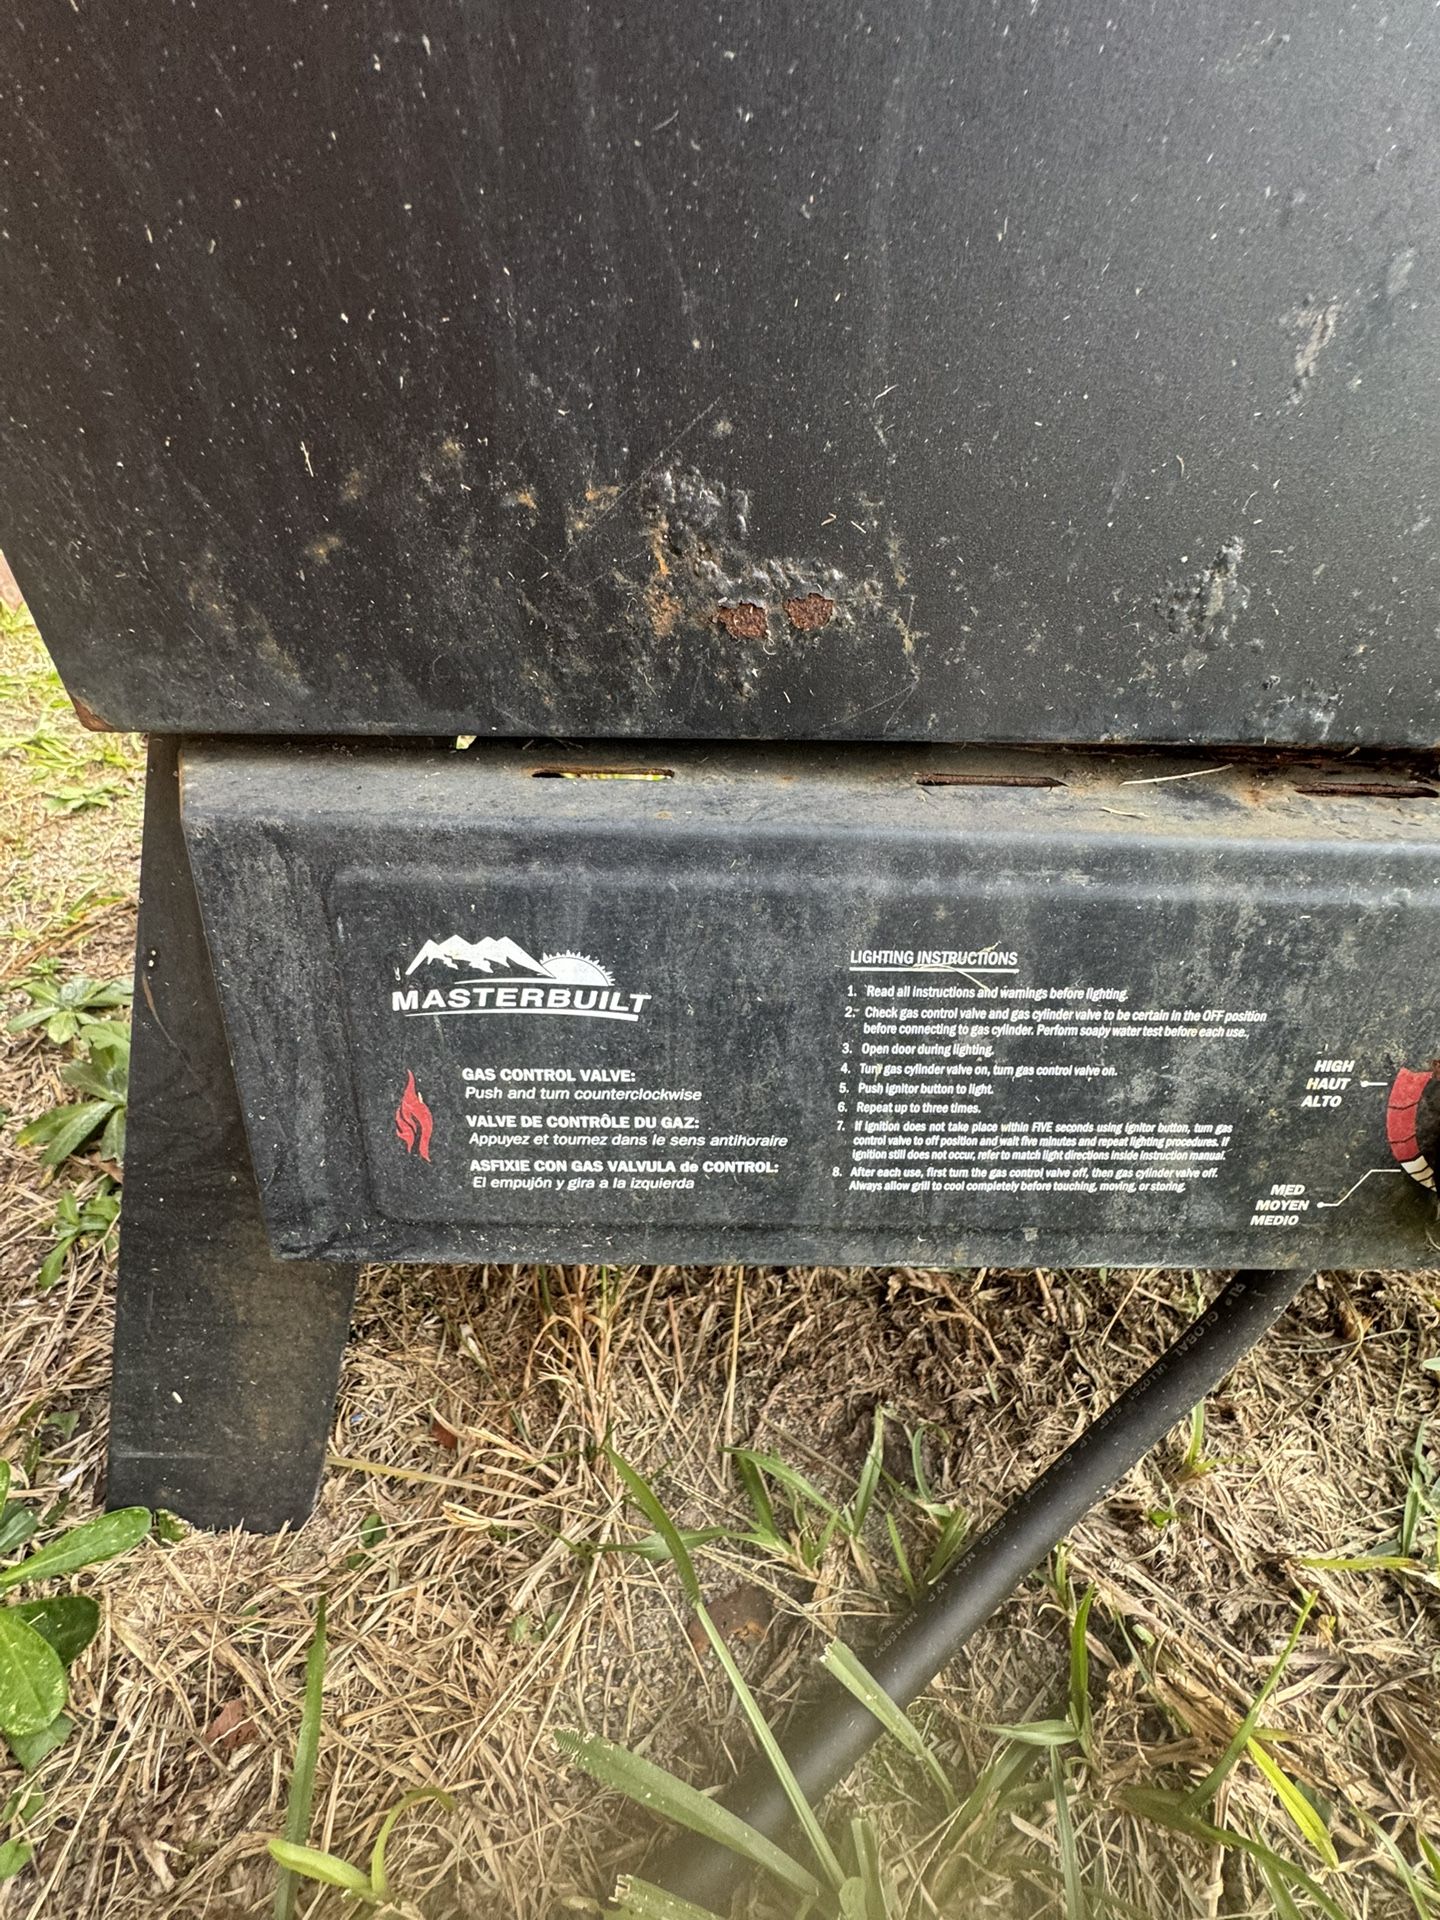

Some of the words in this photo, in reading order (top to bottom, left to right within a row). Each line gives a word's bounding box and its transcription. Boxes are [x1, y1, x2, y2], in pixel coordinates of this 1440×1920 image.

[850, 950, 914, 964] LIGHTING
[917, 950, 1018, 965] INSTRUCTIONS
[392, 987, 652, 1013] MASTERBUILT
[847, 985, 857, 997] 1.
[866, 985, 894, 998] Read
[897, 986, 910, 998] all
[912, 986, 975, 998] instructions
[977, 987, 998, 999] and
[1000, 987, 1047, 1001] warnings
[1050, 988, 1084, 1000] before
[1086, 988, 1128, 1002] lighting.
[844, 1006, 855, 1018] 2.
[865, 1006, 897, 1018] Check
[899, 1009, 918, 1020] gas
[921, 1007, 957, 1019] control
[960, 1007, 986, 1019] valve
[989, 1007, 1008, 1020] and
[1011, 1010, 1029, 1021] gas
[1032, 1008, 1074, 1022] cylinder
[1075, 1008, 1101, 1020] valve
[1103, 1008, 1114, 1021] to
[1117, 1008, 1130, 1021] be
[1132, 1009, 1169, 1021] certain
[1171, 1009, 1181, 1021] in
[1183, 1009, 1201, 1021] the
[1202, 1009, 1225, 1022] OFF
[1225, 1010, 1267, 1024] position
[864, 1022, 896, 1035] before
[899, 1023, 956, 1037] connecting
[958, 1023, 969, 1035] to
[970, 1026, 990, 1037] gas
[991, 1023, 1034, 1037] cylinder.
[1037, 1024, 1078, 1036] Perform
[1080, 1027, 1111, 1038] soapy
[1112, 1024, 1143, 1037] water
[1143, 1025, 1163, 1037] test
[1164, 1025, 1198, 1037] before
[1199, 1025, 1224, 1037] each
[842, 1043, 852, 1055] 3.
[862, 1043, 889, 1057] Open
[891, 1043, 915, 1055] door
[917, 1043, 951, 1057] during
[953, 1044, 994, 1057] lighting.
[840, 1063, 851, 1075] 4.
[884, 1066, 902, 1077] gas
[904, 1064, 945, 1077] cylinder
[947, 1064, 972, 1075] valve
[974, 1067, 990, 1076] on,
[993, 1064, 1014, 1076] turn
[1015, 1067, 1034, 1078] gas
[1036, 1065, 1072, 1076] control
[1074, 1065, 1100, 1076] valve
[1102, 1067, 1118, 1076] on.
[1314, 1060, 1355, 1072] HIGH
[462, 1068, 496, 1082] GAS
[500, 1068, 576, 1082] CONTROL
[580, 1069, 636, 1082] VALVE:
[839, 1082, 850, 1094] 5.
[858, 1082, 883, 1094] Push
[885, 1083, 919, 1096] ignitor
[921, 1083, 954, 1095] button
[956, 1083, 967, 1095] to
[969, 1083, 994, 1097] light.
[1306, 1078, 1351, 1090] HAUT
[465, 1086, 503, 1099] Push
[507, 1086, 536, 1099] and
[539, 1087, 571, 1099] turn
[574, 1087, 702, 1100] counterclockwise
[838, 1101, 848, 1113] 6.
[856, 1101, 893, 1115] Repeat
[894, 1104, 908, 1115] up
[909, 1102, 920, 1113] to
[922, 1102, 948, 1113] three
[950, 1102, 981, 1114] times.
[1301, 1096, 1342, 1107] ALTO
[466, 1116, 516, 1128] VALVE
[521, 1116, 542, 1128] DE
[546, 1114, 630, 1128] CONTRÔLE
[634, 1116, 657, 1128] DU
[661, 1116, 700, 1129] GAZ:
[836, 1120, 845, 1132] 7.
[855, 1120, 864, 1132] If
[865, 1121, 900, 1133] ignition
[903, 1121, 926, 1132] does
[929, 1121, 946, 1132] not
[948, 1121, 969, 1132] take
[972, 1121, 998, 1134] place
[1001, 1121, 1029, 1132] within
[1031, 1121, 1053, 1133] FIVE
[1055, 1121, 1094, 1133] seconds
[1097, 1122, 1123, 1134] using
[1124, 1122, 1156, 1134] ignitor
[1158, 1122, 1191, 1134] button,
[1193, 1122, 1213, 1133] turn
[1215, 1124, 1233, 1135] gas
[469, 1132, 530, 1147] Appuyez
[534, 1132, 549, 1145] et
[553, 1132, 607, 1145] tournez
[612, 1133, 648, 1145] dans
[653, 1133, 666, 1145] le
[670, 1136, 706, 1146] sens
[710, 1133, 788, 1146] antihoraire
[470, 1159, 530, 1172] ASFIXIE
[534, 1160, 567, 1172] CON
[571, 1160, 603, 1172] GAS
[607, 1160, 678, 1172] VALVULA
[680, 1160, 699, 1173] de
[703, 1160, 779, 1173] CONTROL:
[832, 1167, 842, 1177] 8.
[850, 1167, 875, 1177] After
[877, 1167, 900, 1177] each
[903, 1169, 924, 1178] use,
[926, 1167, 946, 1178] first
[949, 1167, 969, 1178] turn
[971, 1167, 988, 1178] the
[989, 1169, 1007, 1179] gas
[1009, 1167, 1043, 1178] control
[1045, 1167, 1070, 1178] valve
[1072, 1167, 1089, 1179] off,
[1092, 1167, 1113, 1178] then
[1115, 1169, 1134, 1180] gas
[1135, 1167, 1175, 1180] cylinder
[1176, 1167, 1200, 1178] valve
[1202, 1167, 1218, 1178] off.
[473, 1176, 486, 1188] El
[490, 1176, 552, 1190] empujón
[555, 1179, 565, 1190] y
[568, 1176, 596, 1190] gira
[599, 1179, 608, 1189] a
[613, 1176, 626, 1189] la
[630, 1176, 695, 1190] izquierda
[849, 1180, 882, 1192] Always
[884, 1180, 911, 1191] allow
[911, 1180, 930, 1192] grill
[932, 1180, 942, 1191] to
[943, 1180, 964, 1191] cool
[966, 1180, 1019, 1192] completely
[1020, 1180, 1051, 1191] before
[1053, 1180, 1097, 1193] touching,
[1100, 1181, 1137, 1193] moving,
[1139, 1183, 1150, 1191] or
[1150, 1181, 1186, 1193] storing.
[1270, 1184, 1305, 1196] MED
[1255, 1200, 1310, 1211] MOYEN
[1250, 1215, 1299, 1226] MEDIO
[1176, 1310, 1220, 1358] GLOBAL
[954, 1552, 976, 1576] MAX
